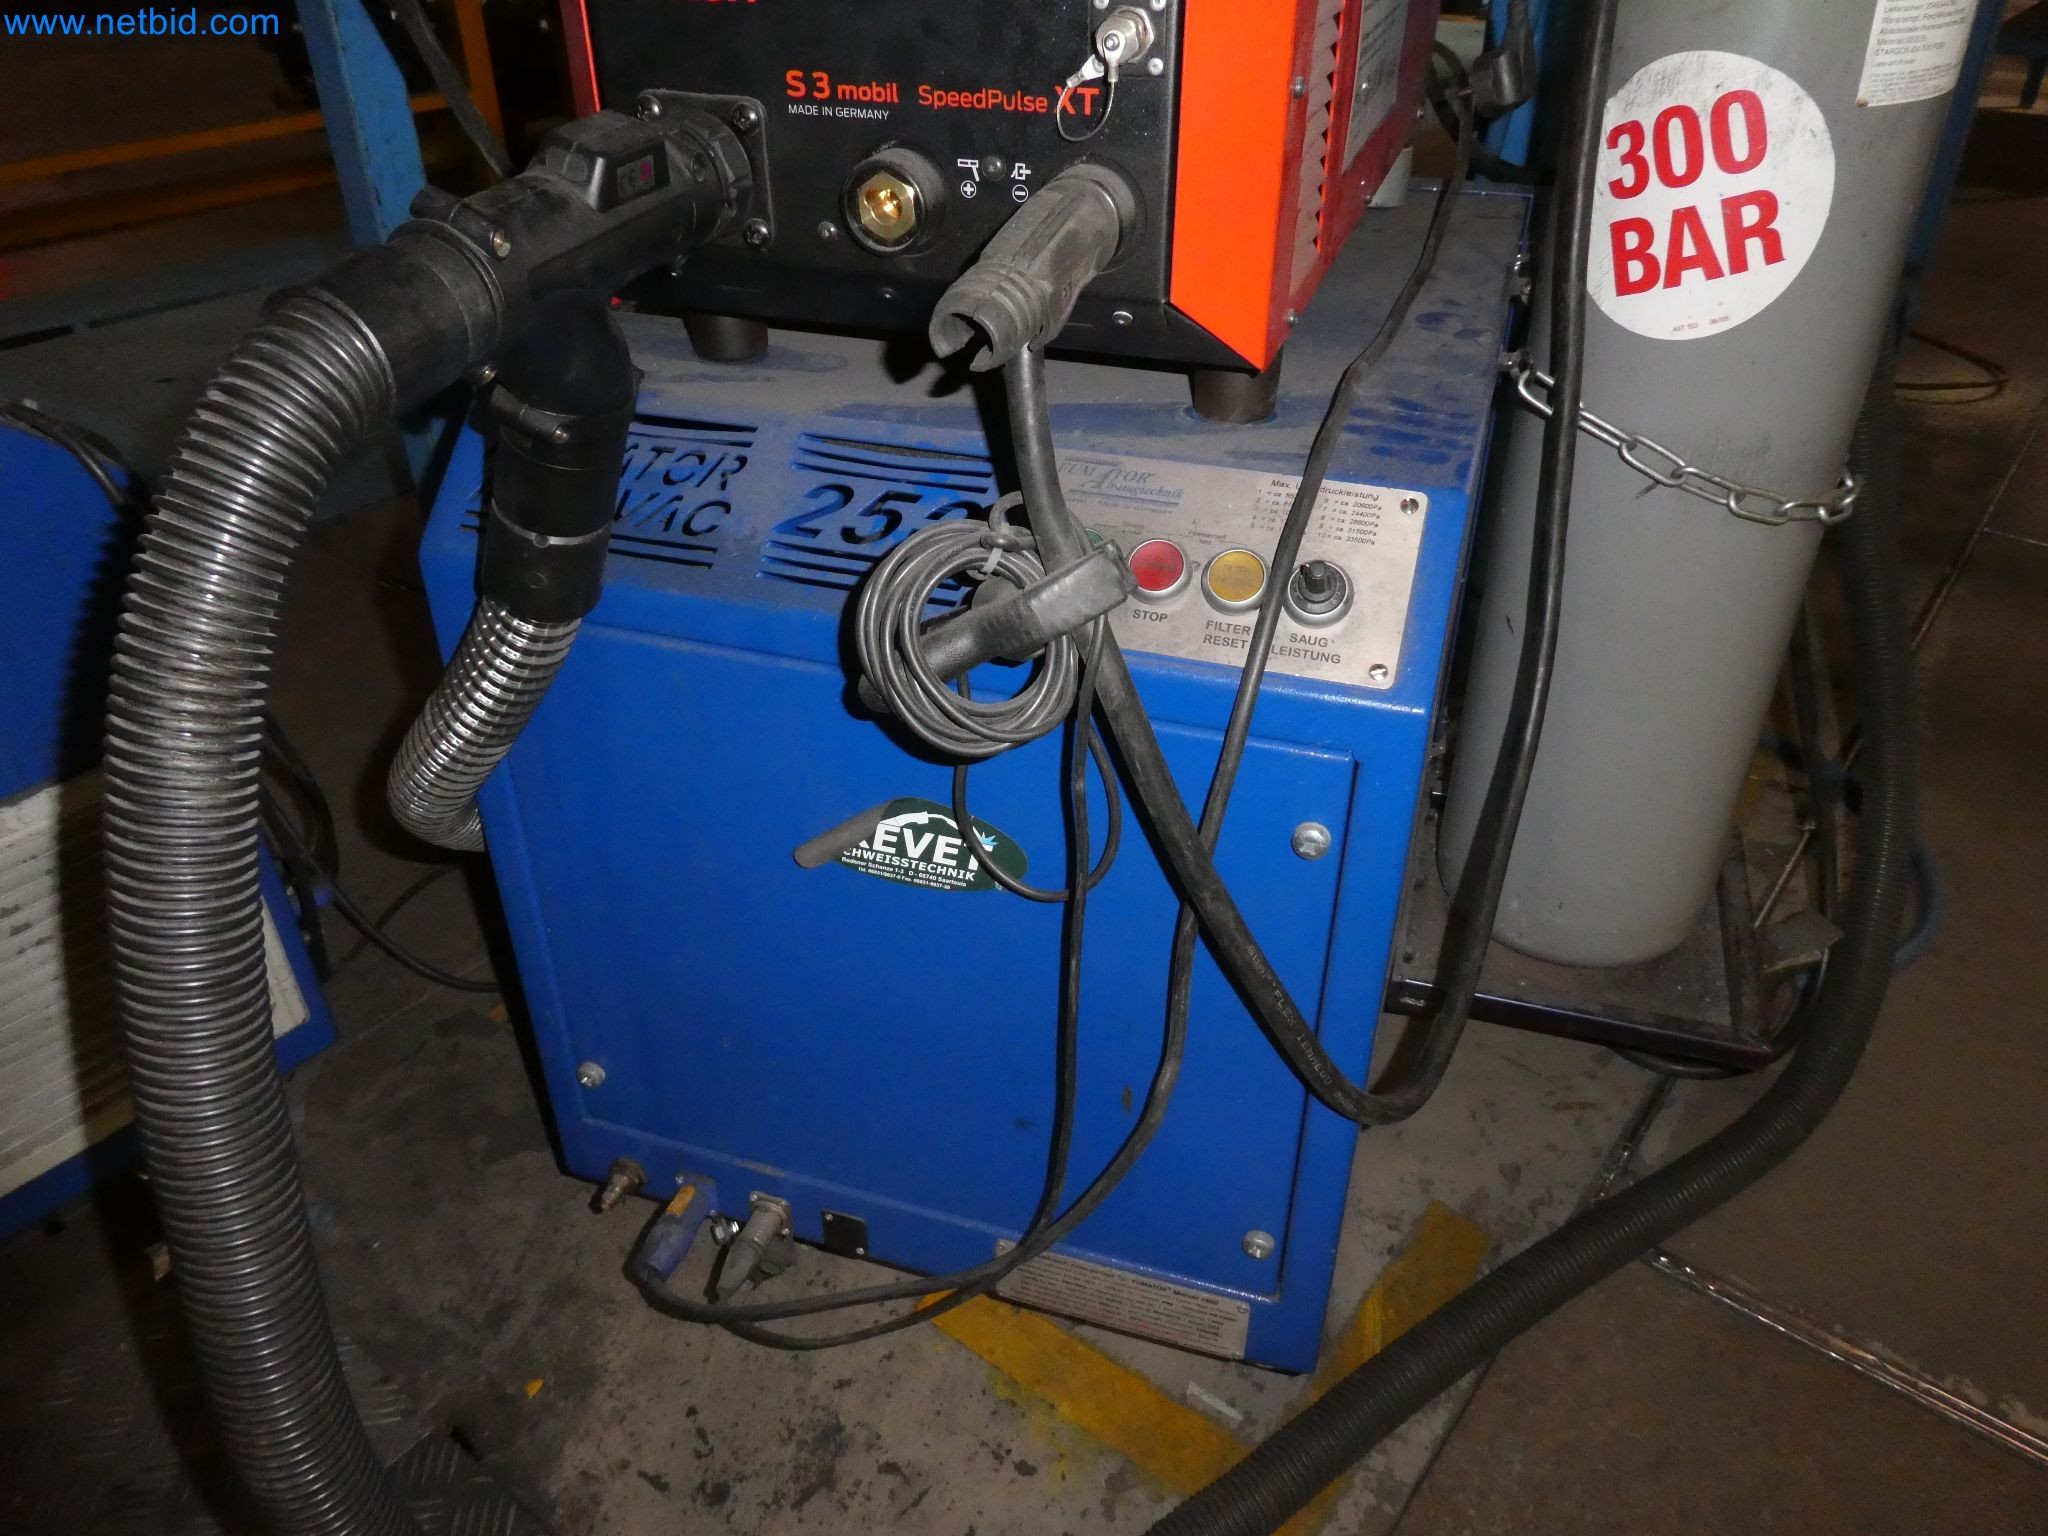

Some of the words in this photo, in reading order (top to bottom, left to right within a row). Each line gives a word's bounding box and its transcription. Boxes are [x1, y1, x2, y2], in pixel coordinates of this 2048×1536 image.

[785, 69, 806, 98] S
[812, 71, 831, 99] 3
[837, 82, 899, 103] mobil
[918, 85, 1047, 113] SpeedPulse
[1053, 85, 1100, 116] XT
[788, 104, 819, 116] MADE
[822, 106, 833, 117] IN
[835, 107, 889, 120] GERMANY
[1606, 89, 1768, 200] 300
[1609, 189, 1786, 297] BAR
[1132, 609, 1168, 623] STOP
[1205, 620, 1251, 636] FILTER
[1202, 634, 1249, 650] RESET
[1270, 645, 1341, 664] LEISTUNG
